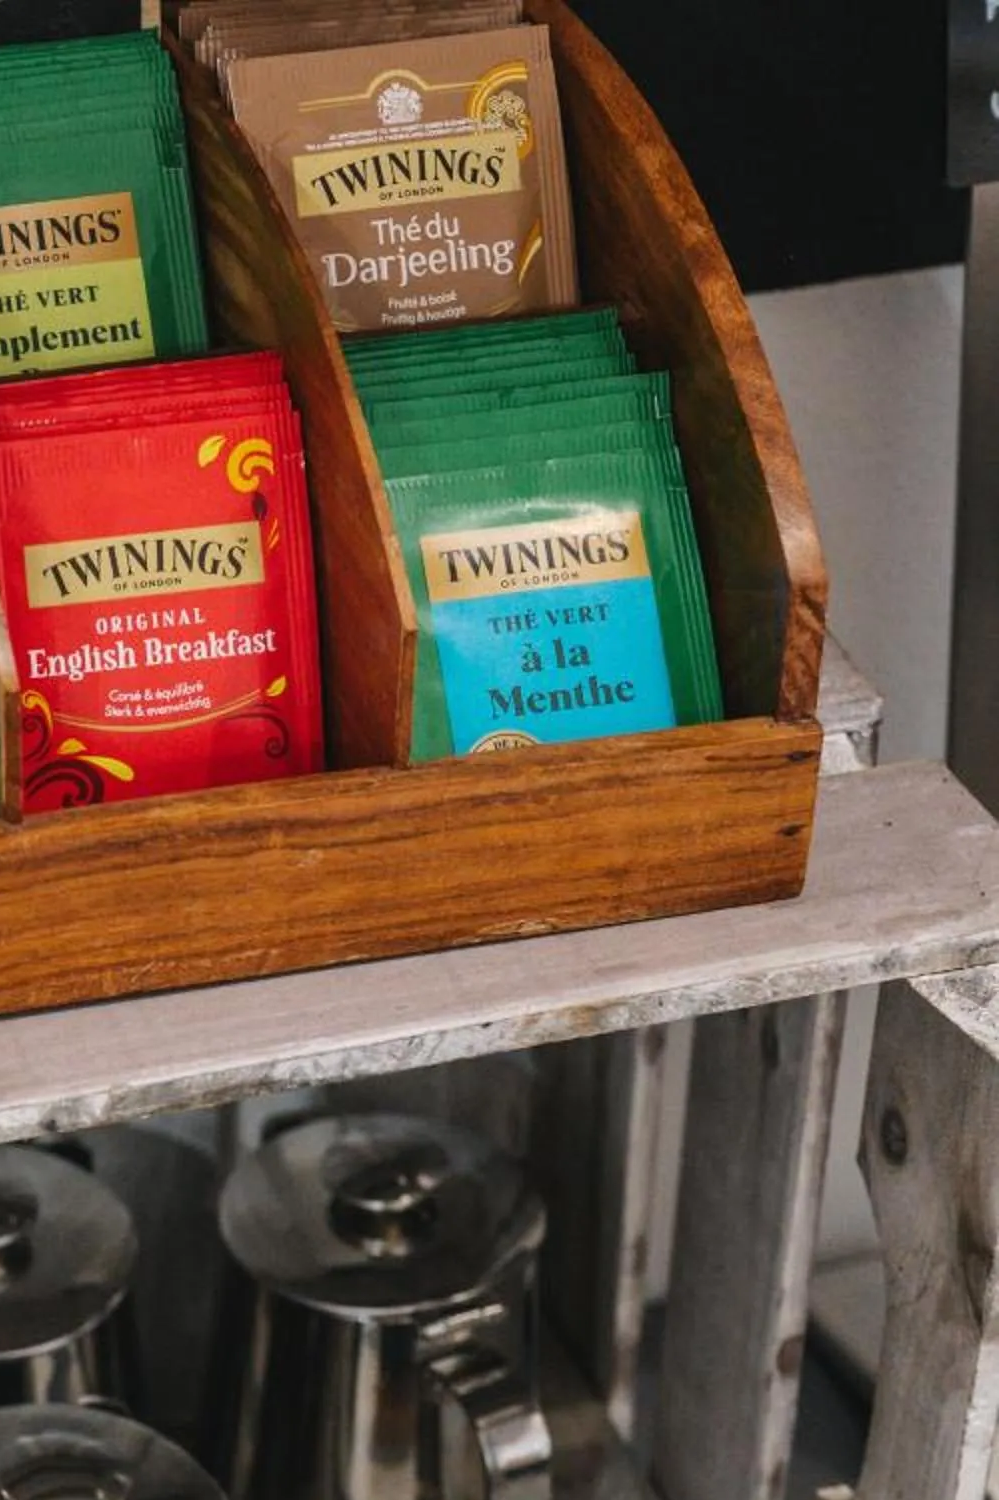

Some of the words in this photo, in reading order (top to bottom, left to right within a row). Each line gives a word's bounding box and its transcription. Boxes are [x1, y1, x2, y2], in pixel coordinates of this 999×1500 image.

[311, 147, 504, 207] TWININGS
[379, 191, 394, 201] OF
[399, 185, 444, 200] LONDON
[370, 216, 422, 245] Thé
[425, 212, 460, 239] du
[15, 252, 70, 268] LONDON
[321, 239, 515, 287] Darjeeling
[37, 286, 98, 309] VERT
[42, 537, 248, 598] TWININGS
[439, 529, 630, 584] TWININGS
[112, 581, 128, 592] OF
[134, 577, 182, 590] LONDON
[501, 578, 518, 589] OF
[523, 571, 580, 586] LONDON
[96, 607, 207, 635] ORIGINAL
[487, 604, 539, 635] THÉ
[548, 603, 610, 628] VERT
[27, 641, 137, 682] English
[144, 627, 276, 666] Breakfast
[520, 644, 542, 673] à
[553, 638, 591, 668] la
[488, 675, 635, 720] Menthe
